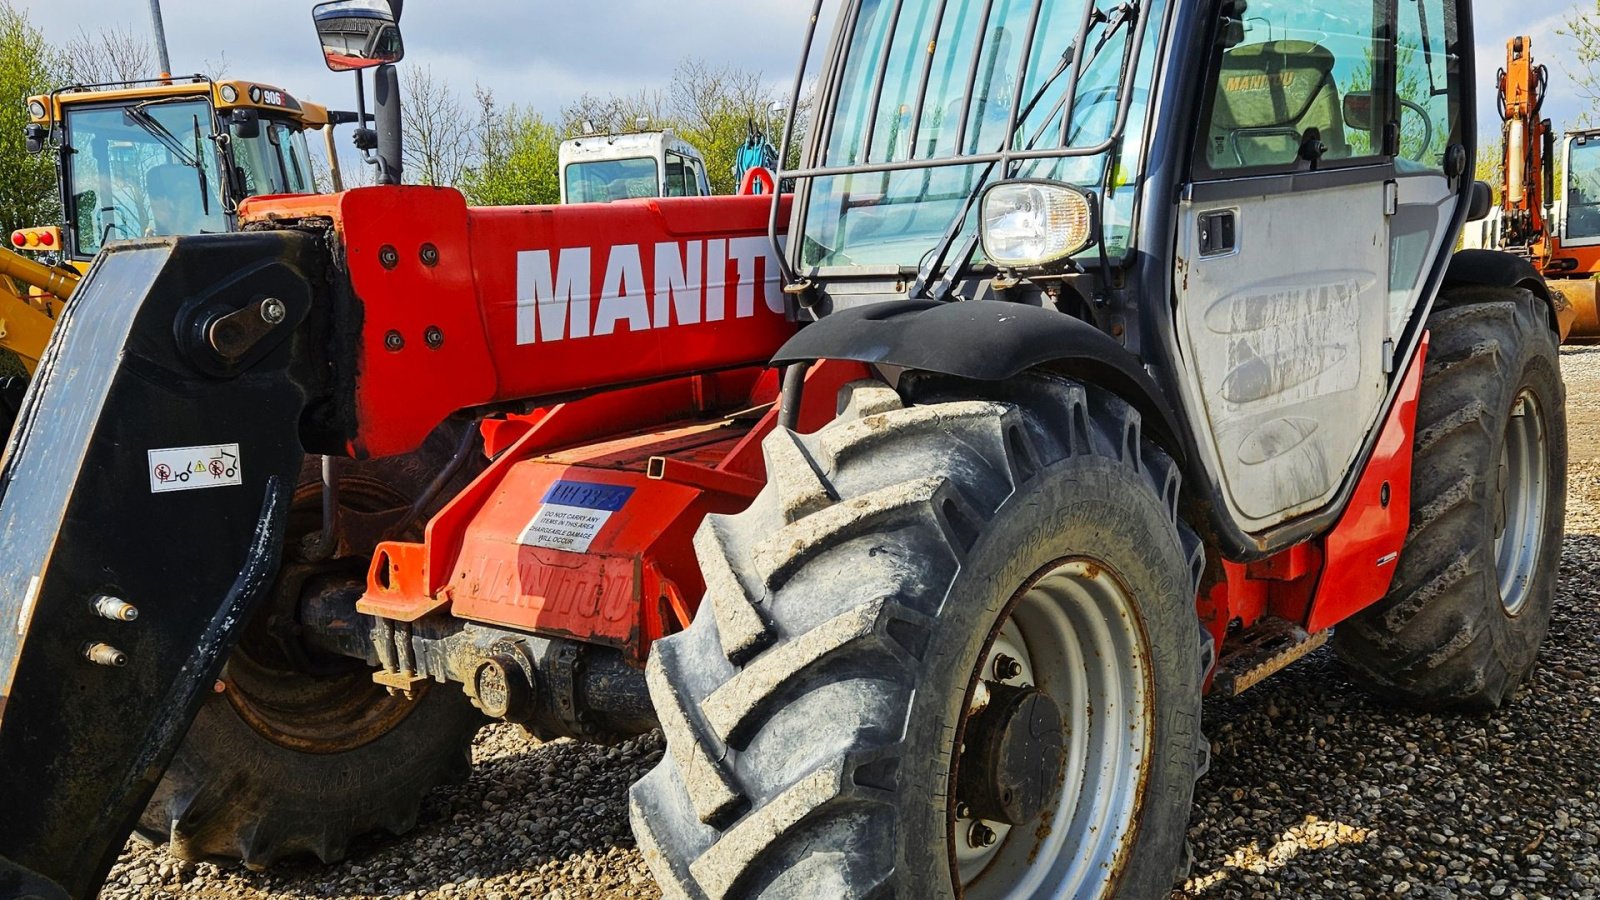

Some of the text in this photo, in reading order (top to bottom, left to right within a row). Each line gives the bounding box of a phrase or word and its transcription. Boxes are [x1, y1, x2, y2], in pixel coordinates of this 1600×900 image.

[1226, 71, 1294, 91] MANITOU
[516, 235, 786, 346] MANIT
[552, 536, 573, 544] OCCUR
[566, 531, 592, 539] DAMAGE
[453, 557, 633, 622] MANITOU
